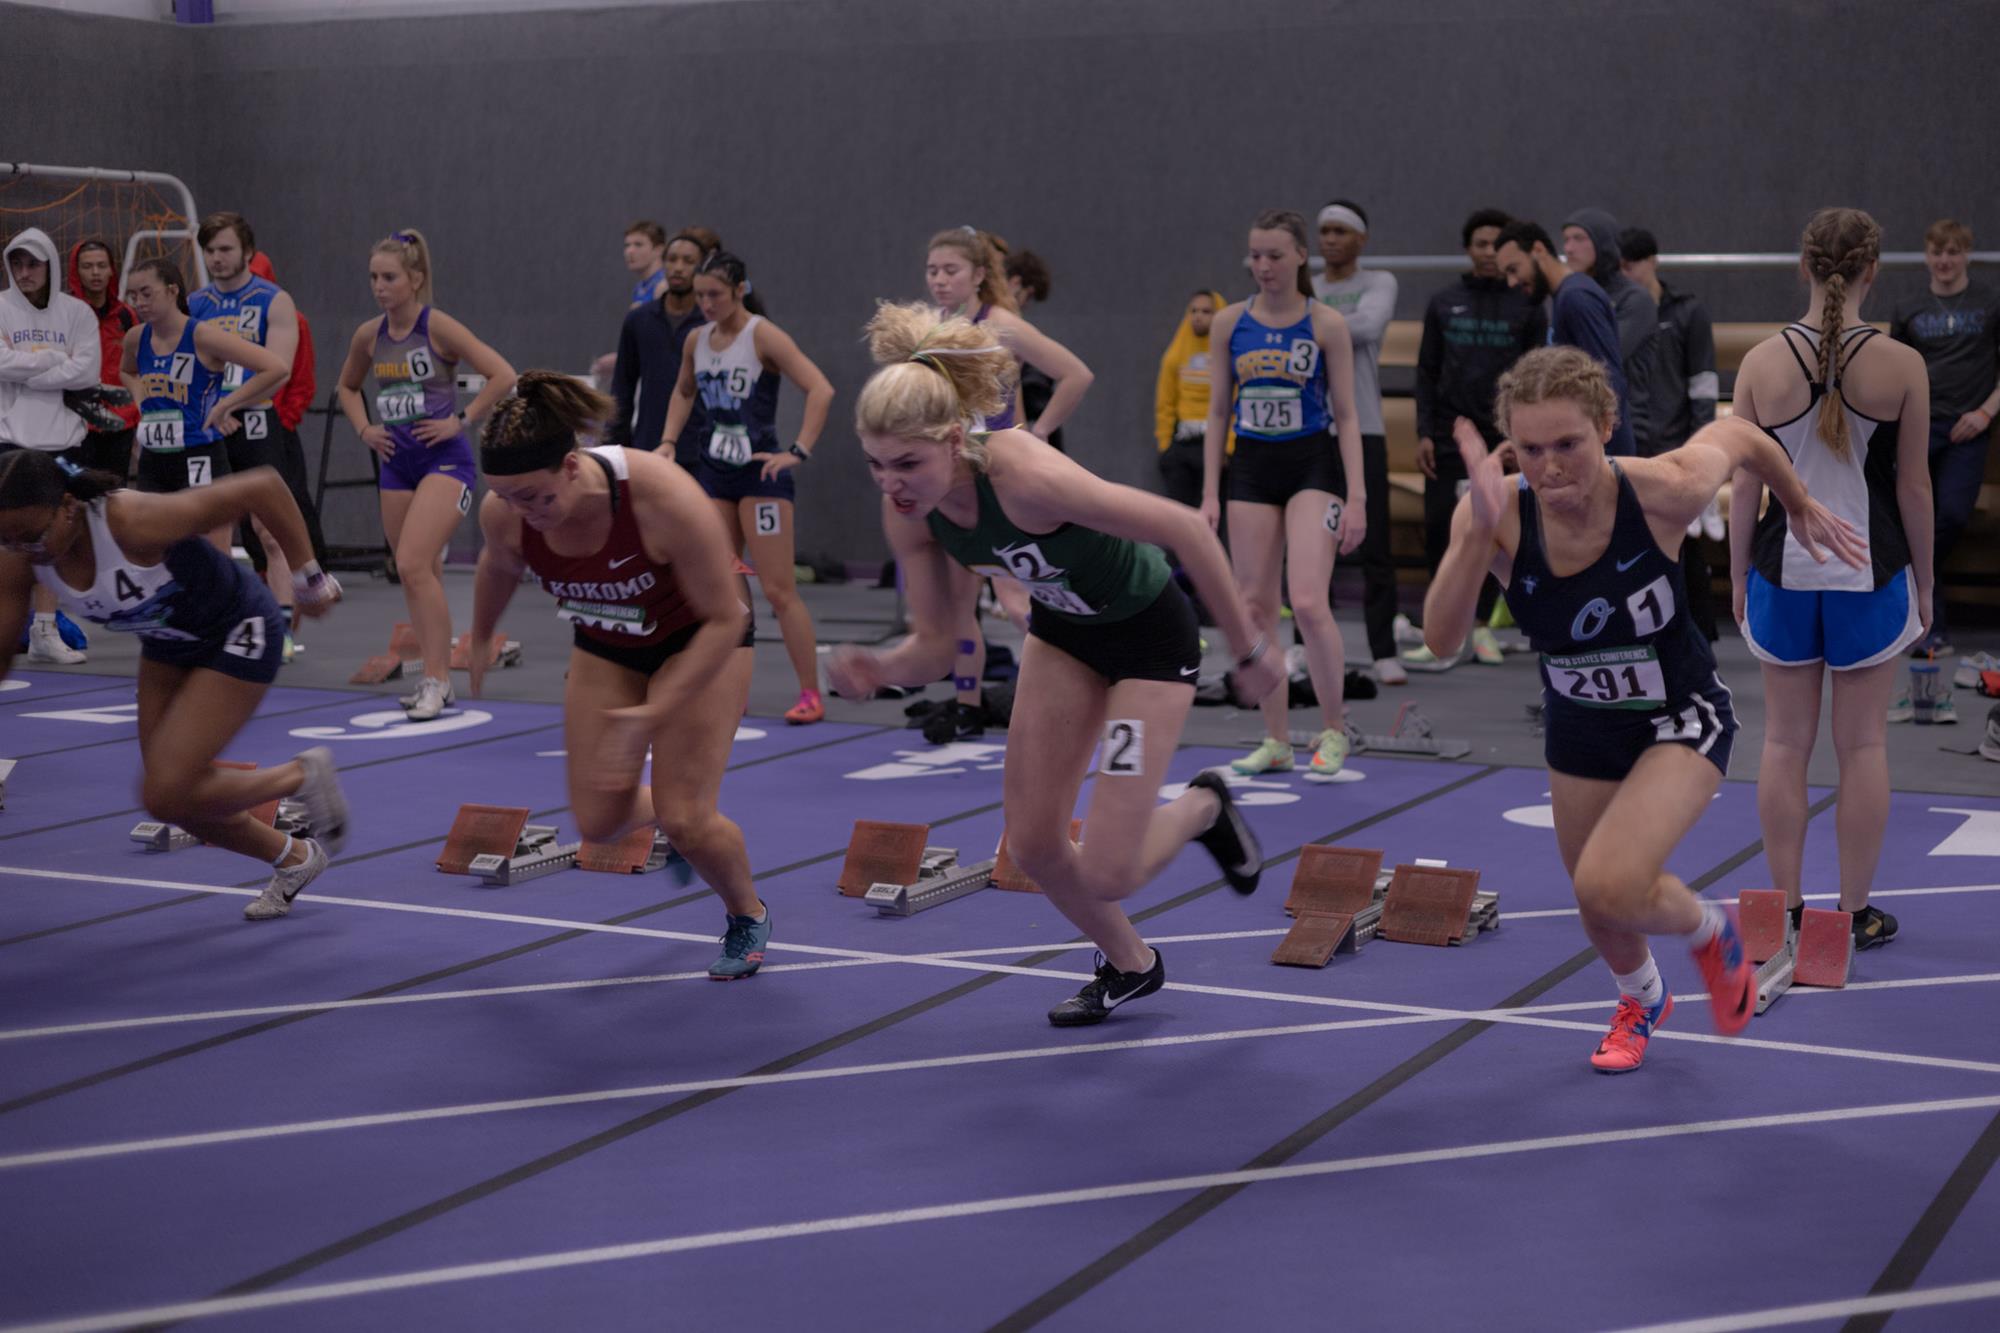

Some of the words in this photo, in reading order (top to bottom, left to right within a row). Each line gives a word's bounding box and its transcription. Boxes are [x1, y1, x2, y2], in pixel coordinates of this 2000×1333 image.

[242, 308, 256, 330] 2
[13, 329, 66, 344] BRESCIA
[175, 356, 190, 379] 7
[411, 352, 428, 377] 6
[1294, 343, 1313, 372] 3
[730, 367, 748, 393] 5
[247, 414, 264, 436] 2
[1250, 401, 1291, 428] 125
[144, 423, 175, 446] 144
[190, 460, 206, 483] 7
[460, 485, 471, 511] 6
[759, 505, 775, 532] 5
[1327, 503, 1341, 531] 3
[115, 569, 145, 602] 4
[549, 571, 657, 601] KOKOMO
[1638, 588, 1664, 629] 1
[234, 622, 257, 657] 4
[1571, 654, 1600, 665] STATES
[1600, 648, 1649, 662] CONFERENCE
[1564, 666, 1647, 701] 291
[1110, 723, 1135, 771] 2
